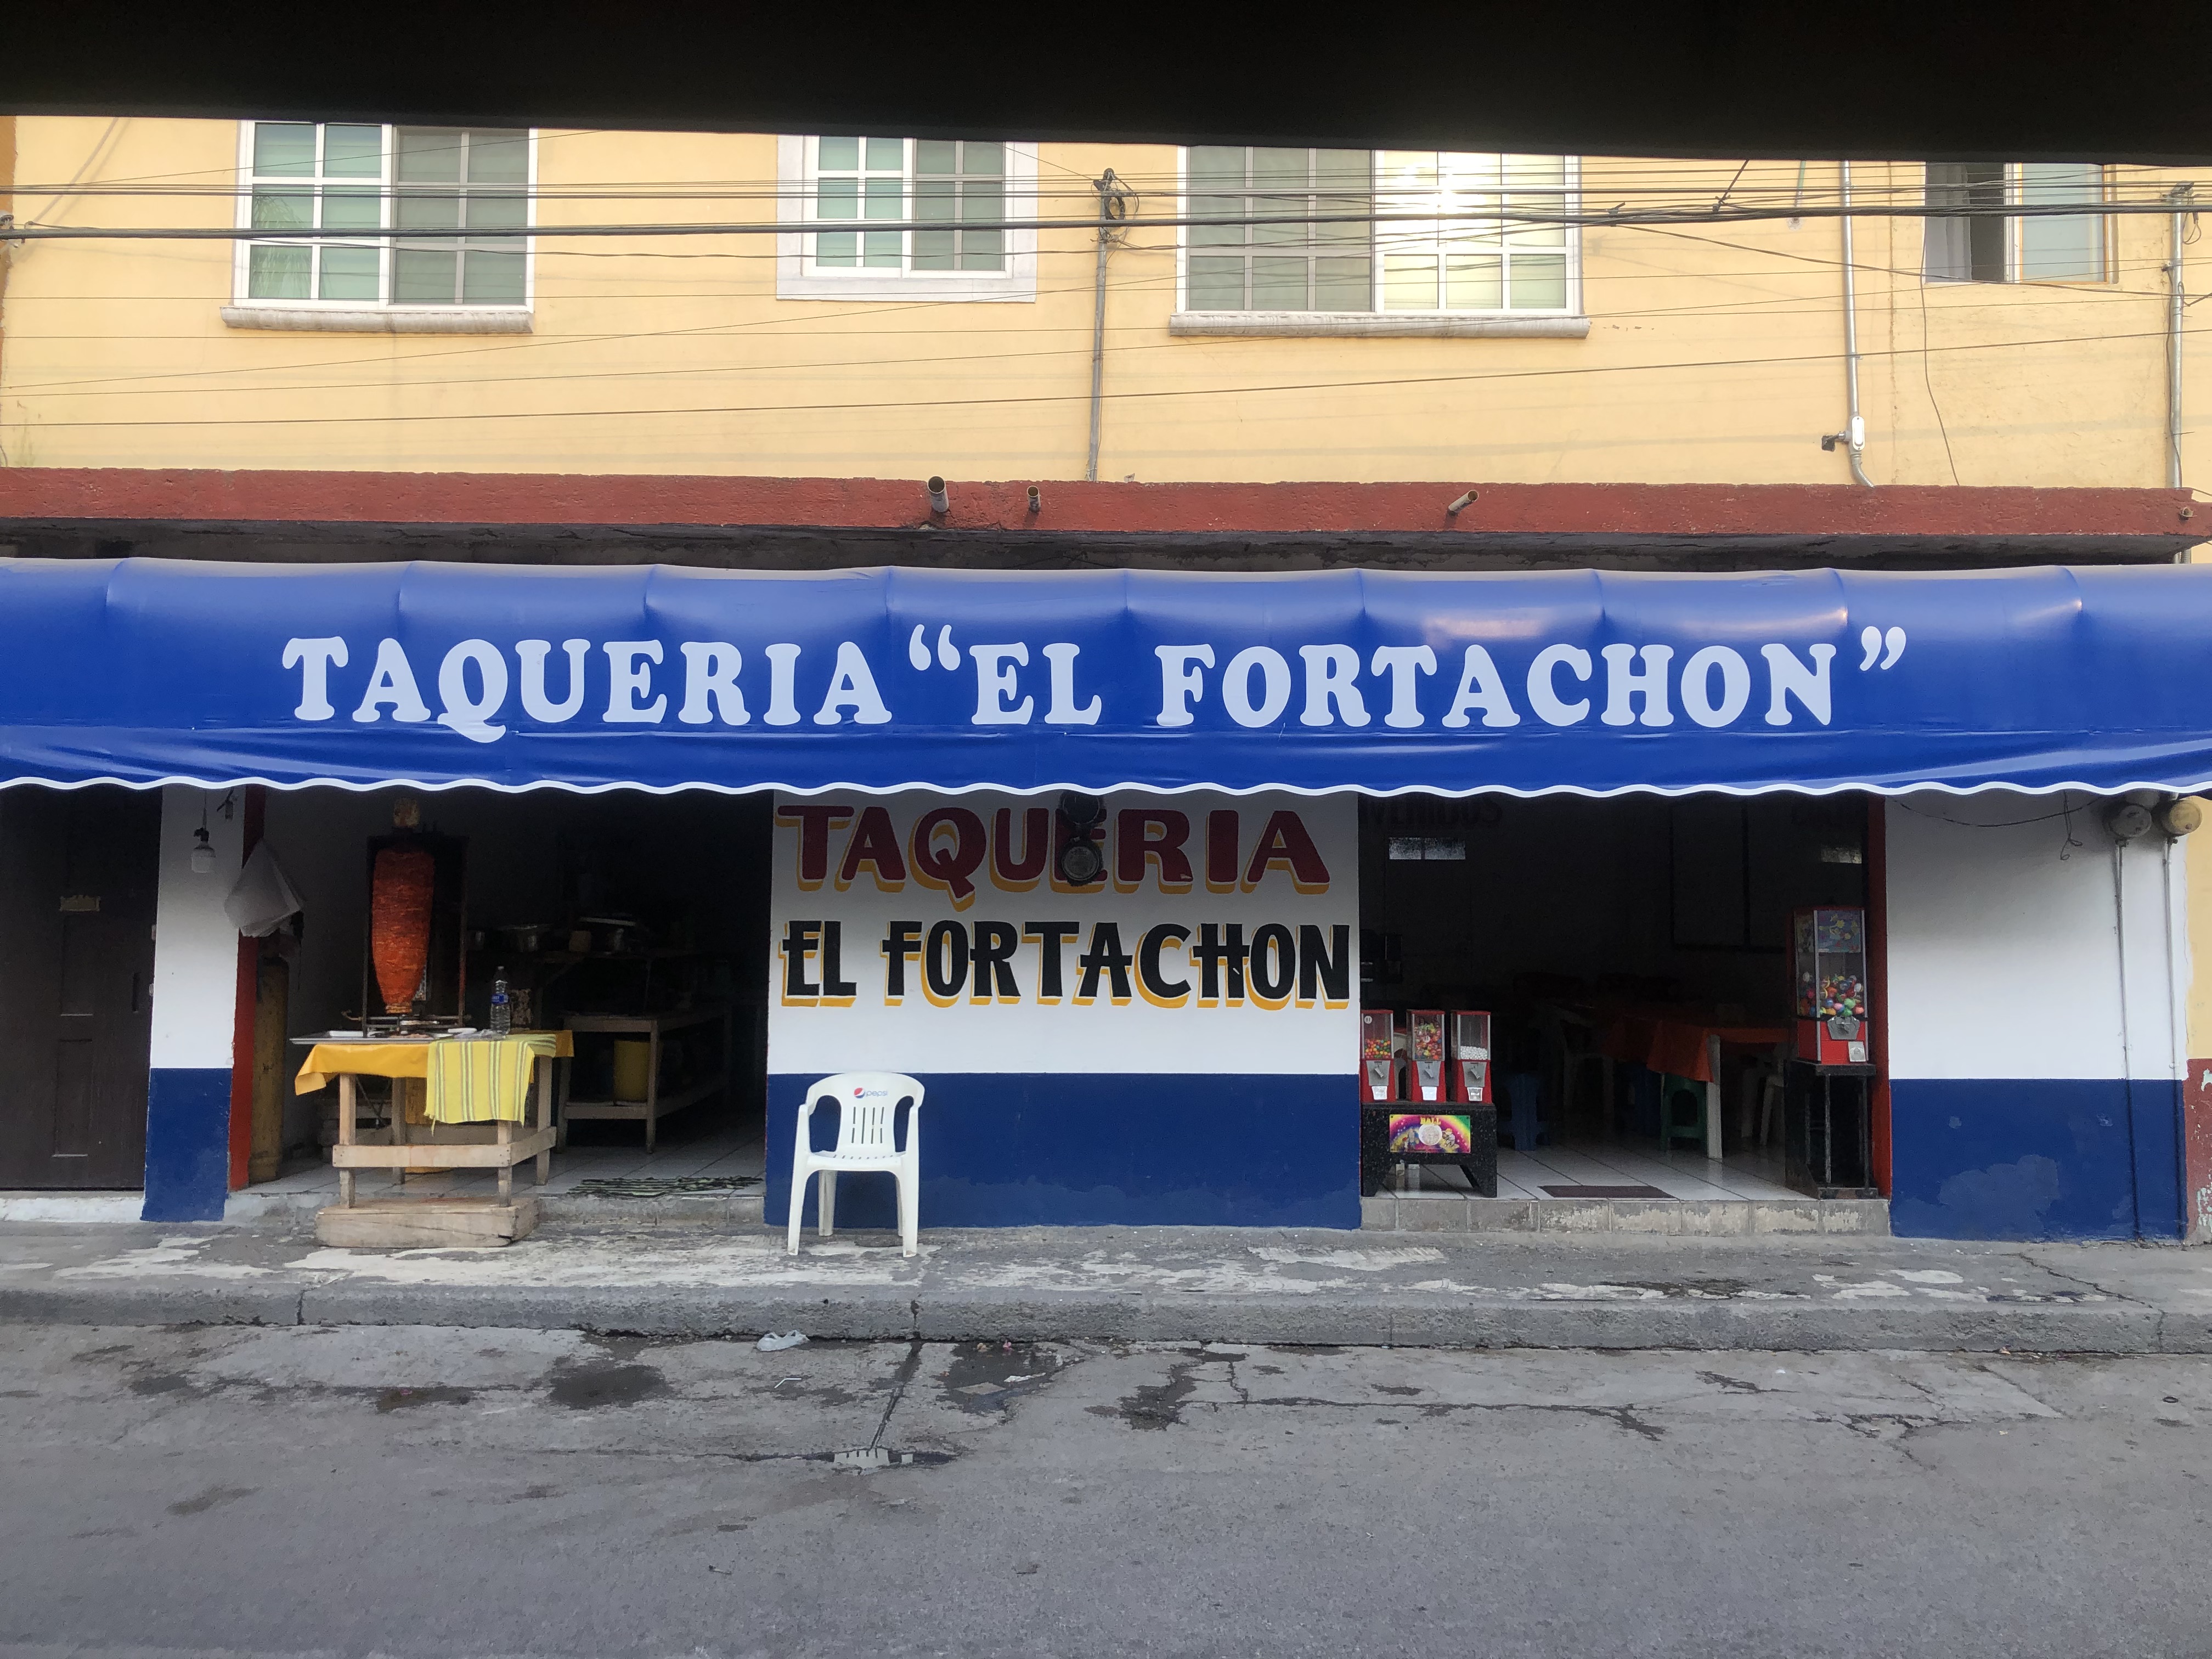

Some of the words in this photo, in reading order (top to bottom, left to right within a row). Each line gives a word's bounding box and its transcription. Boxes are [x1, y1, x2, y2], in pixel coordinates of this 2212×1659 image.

[283, 636, 891, 738] TAQUERIA
[910, 625, 1102, 725] “EL
[1155, 625, 1906, 728] FORTACHON”
[776, 805, 1331, 912] TAQUERIA
[780, 920, 857, 1007] EL
[881, 919, 1350, 1009] FORTACHON
